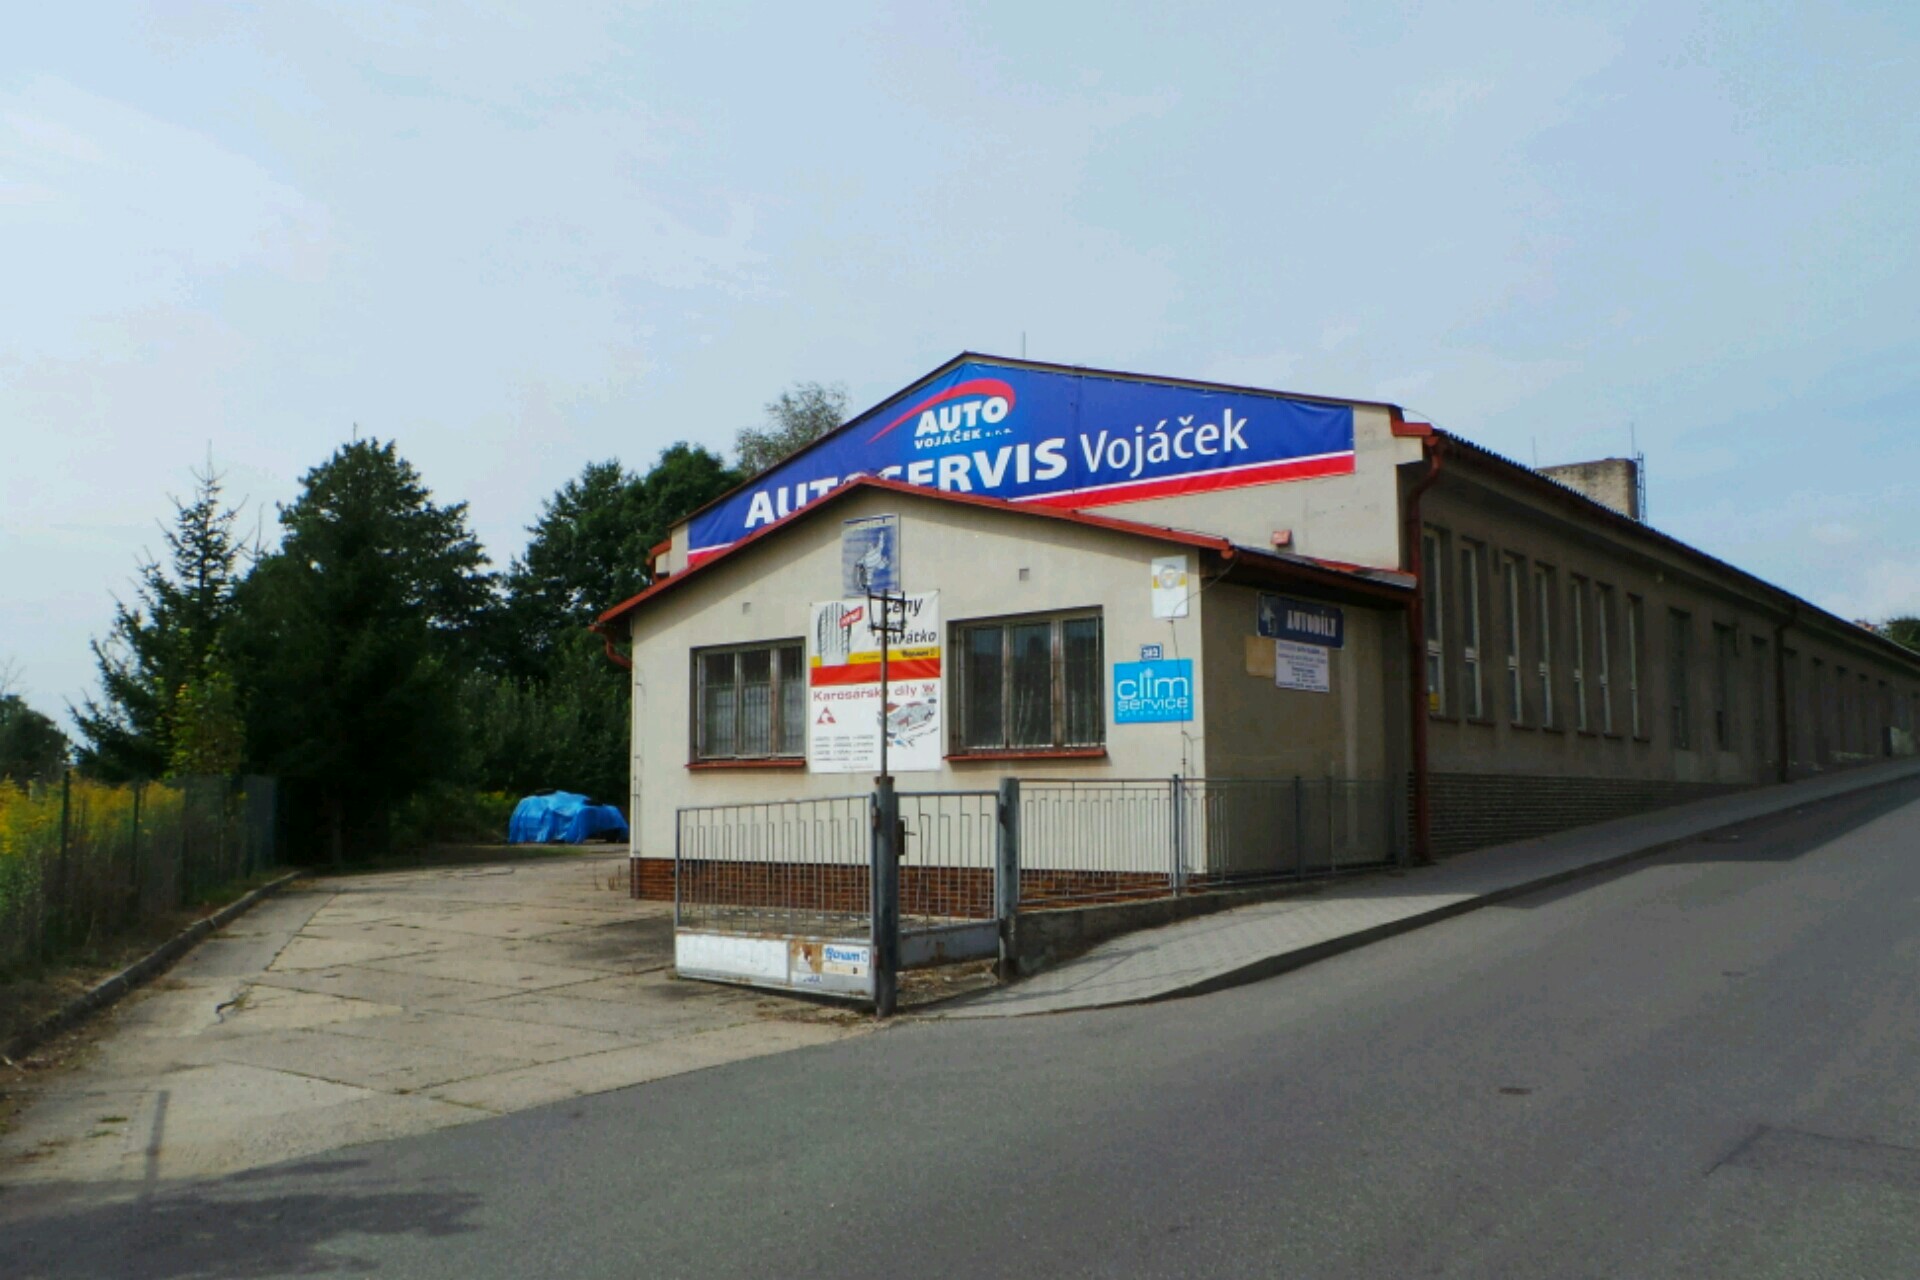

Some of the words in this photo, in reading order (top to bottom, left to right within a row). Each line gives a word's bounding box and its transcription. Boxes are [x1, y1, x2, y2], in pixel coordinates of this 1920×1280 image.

[914, 396, 1008, 437] AUTO
[914, 427, 981, 449] VOJÁČEK
[1080, 408, 1248, 478] Vojáček
[813, 686, 889, 701] Karosářsk
[1117, 667, 1188, 700] clim
[1117, 696, 1188, 712] service
